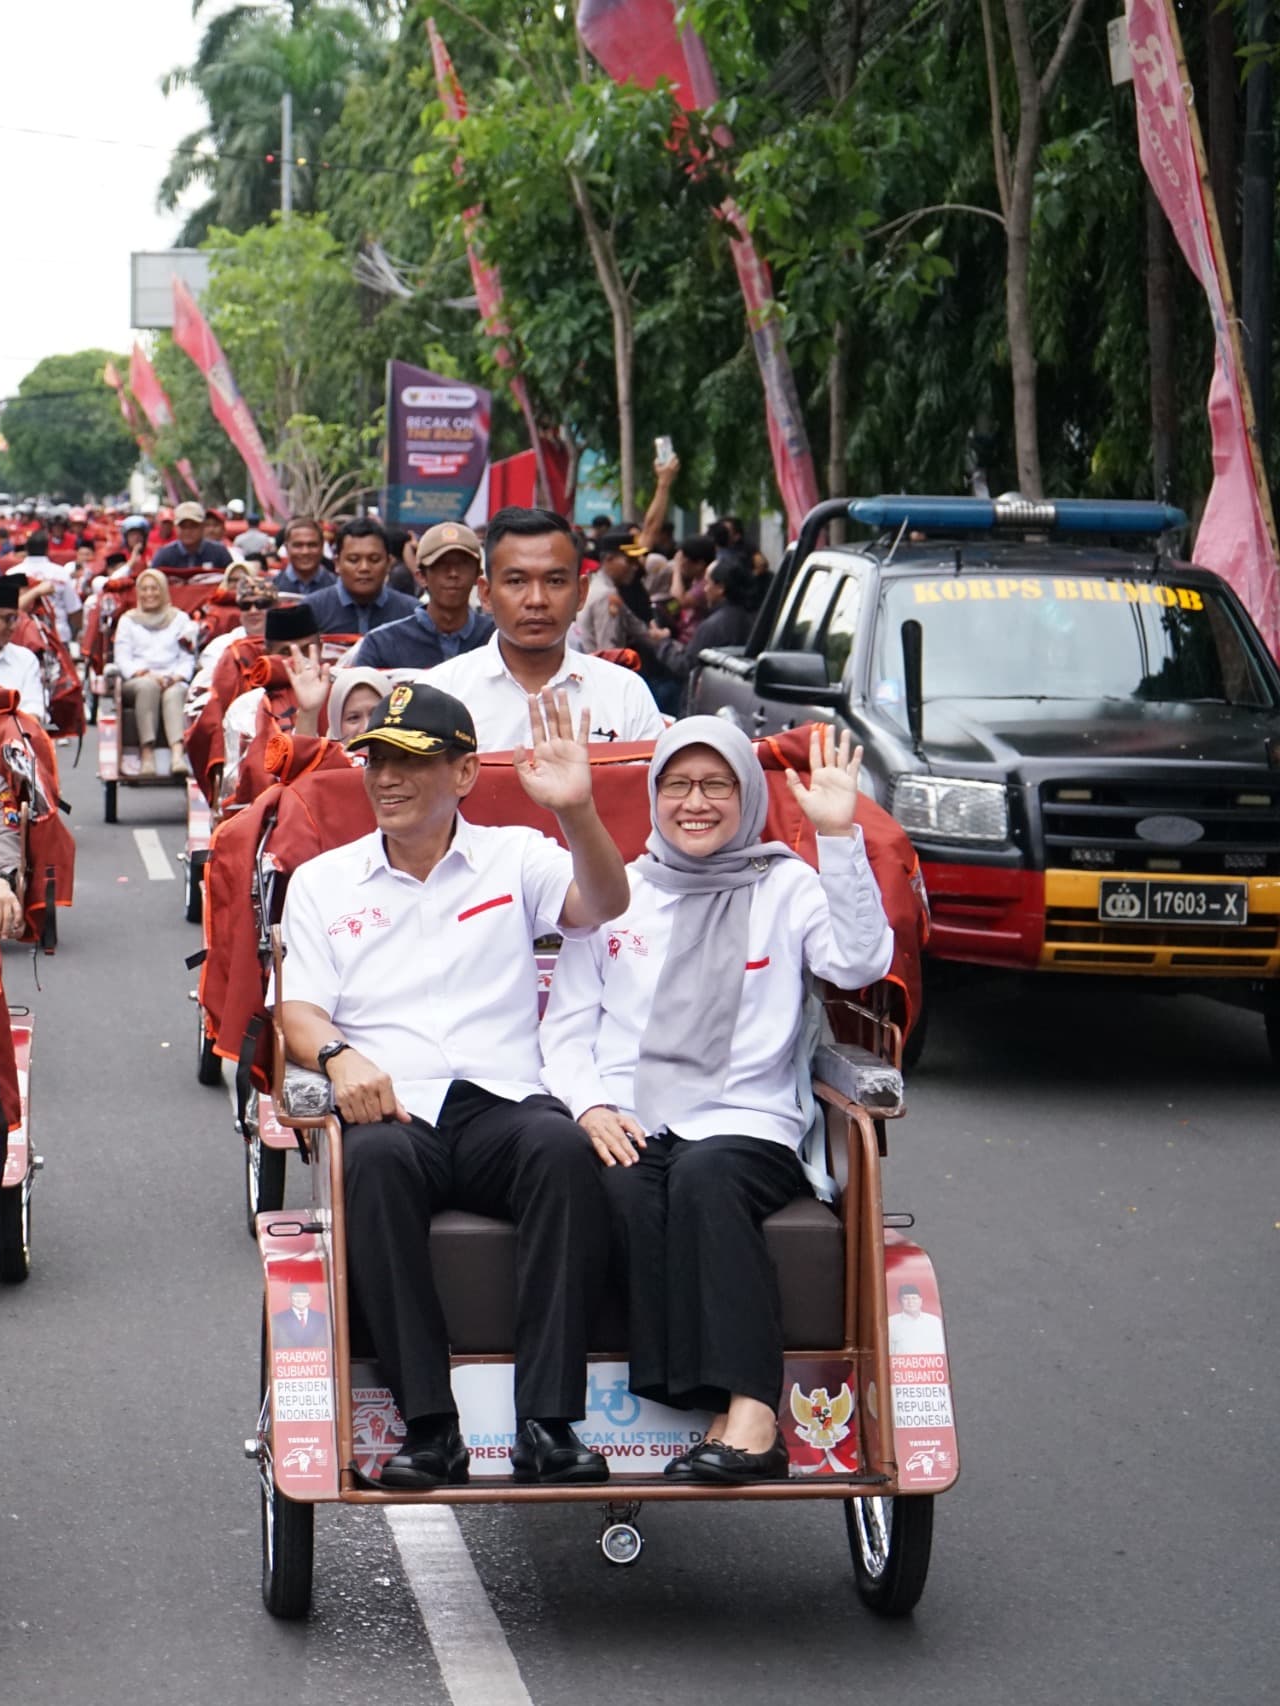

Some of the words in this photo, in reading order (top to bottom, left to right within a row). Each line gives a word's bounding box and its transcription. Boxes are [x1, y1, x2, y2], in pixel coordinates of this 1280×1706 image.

[452, 417, 474, 430] ON
[912, 579, 1044, 603] KORPS
[1052, 578, 1204, 611] BRIMOB
[275, 1351, 327, 1362] PRABOWO
[892, 1356, 943, 1368] PRABOWO
[277, 1365, 327, 1377] SUBIANTO
[894, 1370, 944, 1382] SUBIANTO
[278, 1380, 328, 1392] PRESIDEN
[896, 1386, 946, 1398] PRESIDEN
[278, 1394, 328, 1406] REPUBLIK
[354, 1391, 392, 1399] YAYASA
[897, 1400, 948, 1412] REPUBLIK
[276, 1408, 331, 1420] INDONESIA
[896, 1414, 952, 1426] INDONESIA
[622, 1432, 686, 1444] LISTRIK
